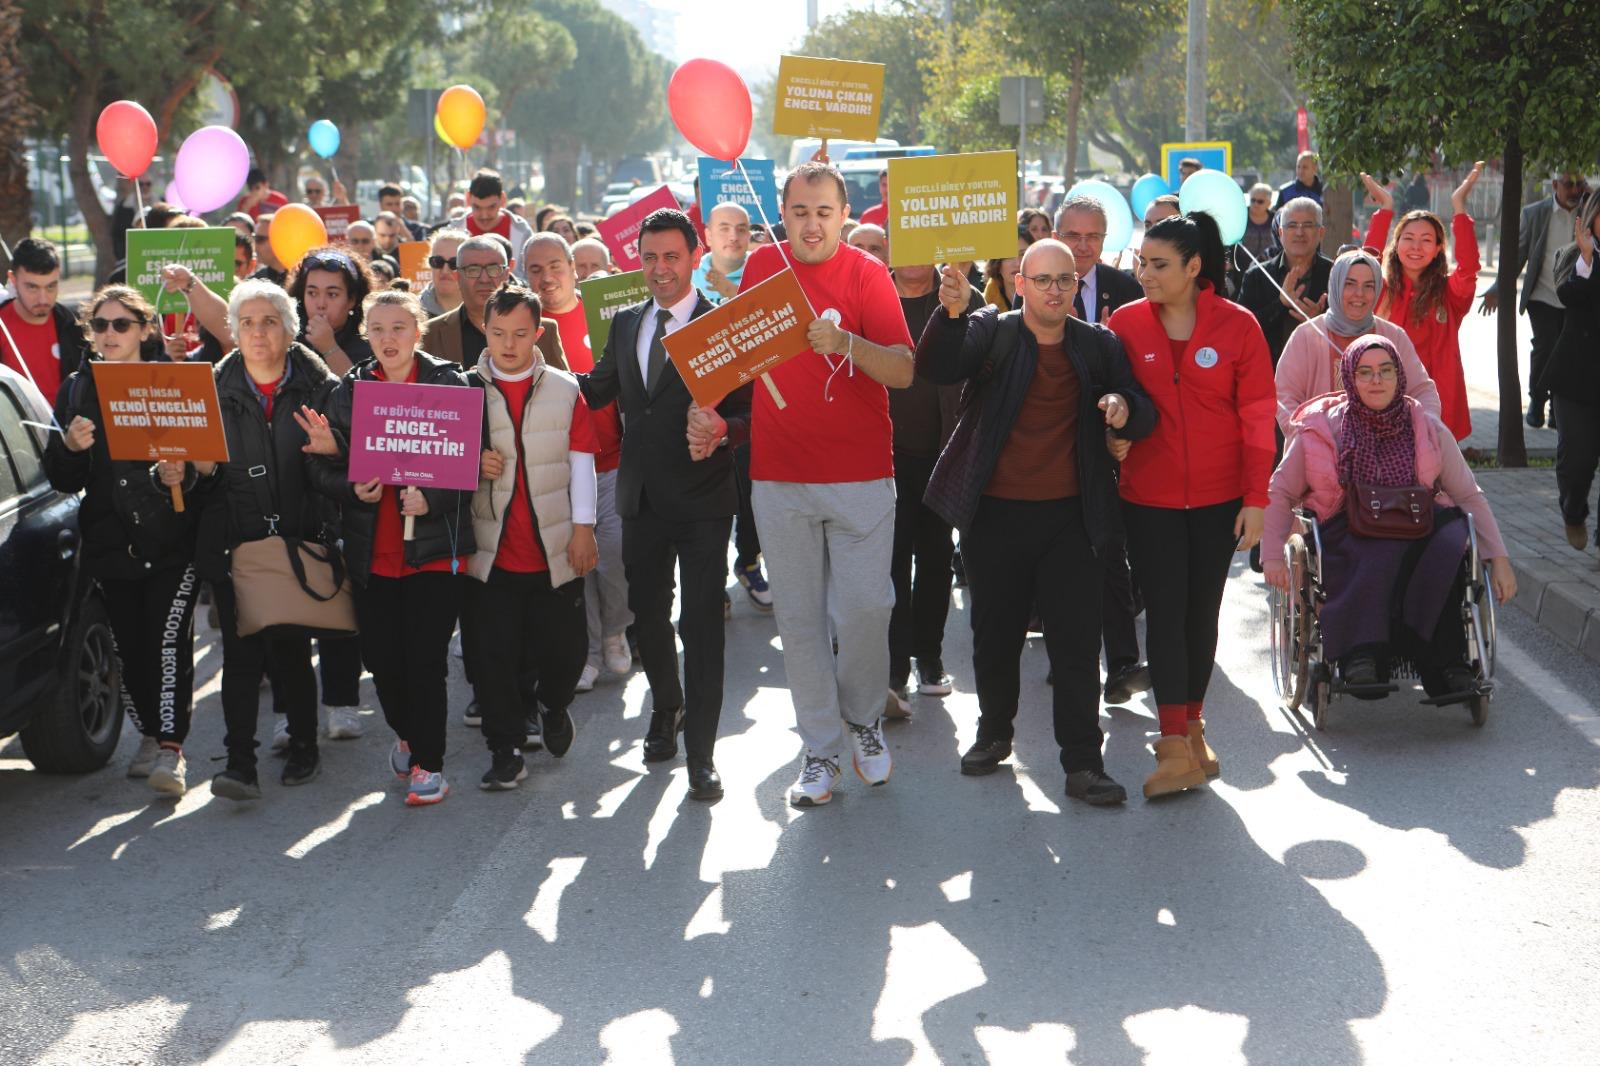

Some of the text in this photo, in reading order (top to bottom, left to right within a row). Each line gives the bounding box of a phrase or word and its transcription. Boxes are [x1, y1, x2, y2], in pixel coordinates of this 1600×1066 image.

[786, 86, 872, 103] YOLUNA ÇIKAN
[784, 98, 871, 114] ENGEL VARDIR!
[905, 184, 939, 194] ENGELLİ
[941, 182, 965, 192] BİREY
[901, 192, 1006, 211] YOLUNA ÇIKAN
[901, 208, 1007, 229] ENGEL VARDIR!
[137, 274, 162, 285] ORT
[603, 287, 639, 300] ENGELSİZ
[707, 308, 765, 344] HER İNSAN
[688, 302, 794, 368] KENDİ ENGELİNİ
[695, 317, 798, 378] KENDİ YARATIR!
[128, 385, 181, 397] HER İNSAN
[109, 398, 206, 413] KENDİ ENGELİNİ
[373, 405, 460, 421] EN BÜYÜK ENGEL
[114, 413, 208, 428] KENDİ YARATIR!
[385, 420, 447, 436] ENGEL-
[365, 436, 464, 456] LENMEKTİR!
[162, 598, 187, 646] BECOOL
[161, 648, 176, 691] BECOOL
